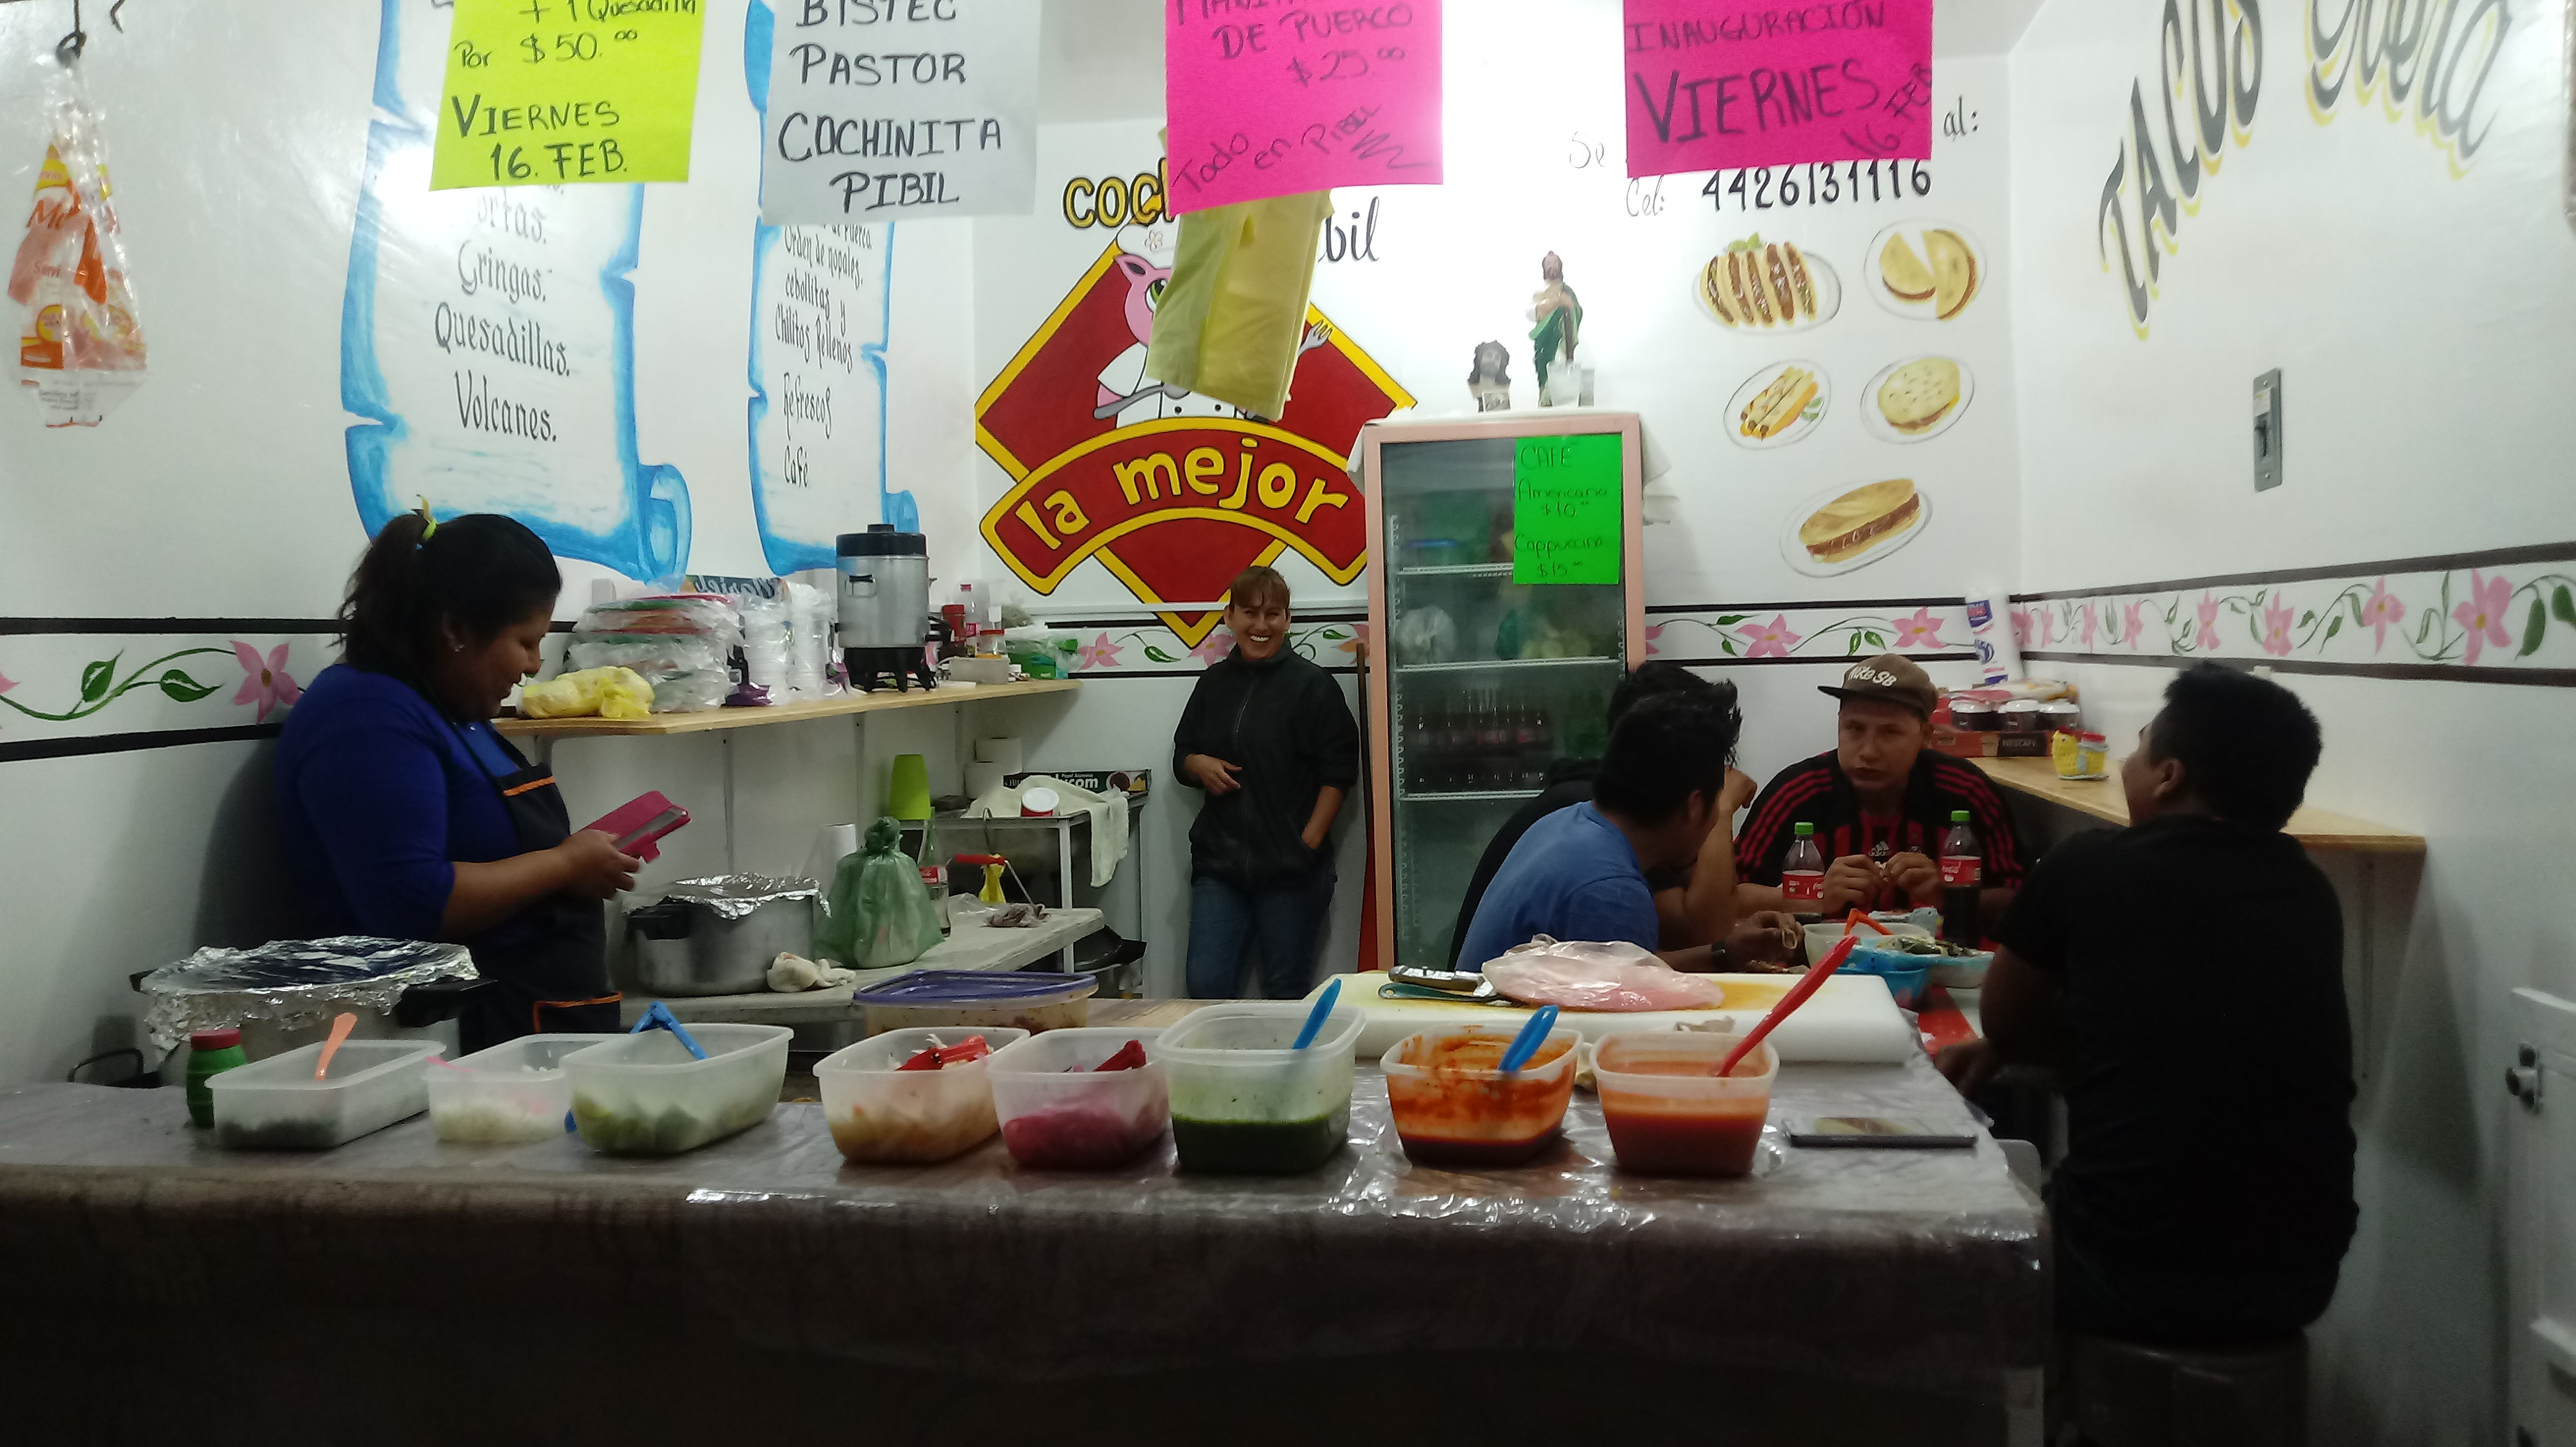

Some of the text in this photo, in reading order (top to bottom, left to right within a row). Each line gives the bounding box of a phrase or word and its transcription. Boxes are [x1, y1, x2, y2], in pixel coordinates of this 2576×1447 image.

[454, 40, 494, 68] Por
[789, 42, 966, 85] PASTOR
[1211, 24, 1268, 59] DE
[451, 94, 620, 138] VIERNES
[1634, 57, 1880, 144] VIERNES
[778, 112, 1001, 162] COCHINITA
[543, 139, 629, 180] FEB.
[1172, 132, 1250, 193] Todo
[829, 170, 960, 214] PIBIL
[1626, 158, 1932, 217] Cel: 4426131116
[815, 233, 825, 266] de
[435, 301, 570, 377] Quesadillas.
[840, 299, 846, 338] y
[454, 369, 558, 442] Volcanes.
[1014, 437, 1350, 551] la mejor
[1872, 670, 1898, 688] SB
